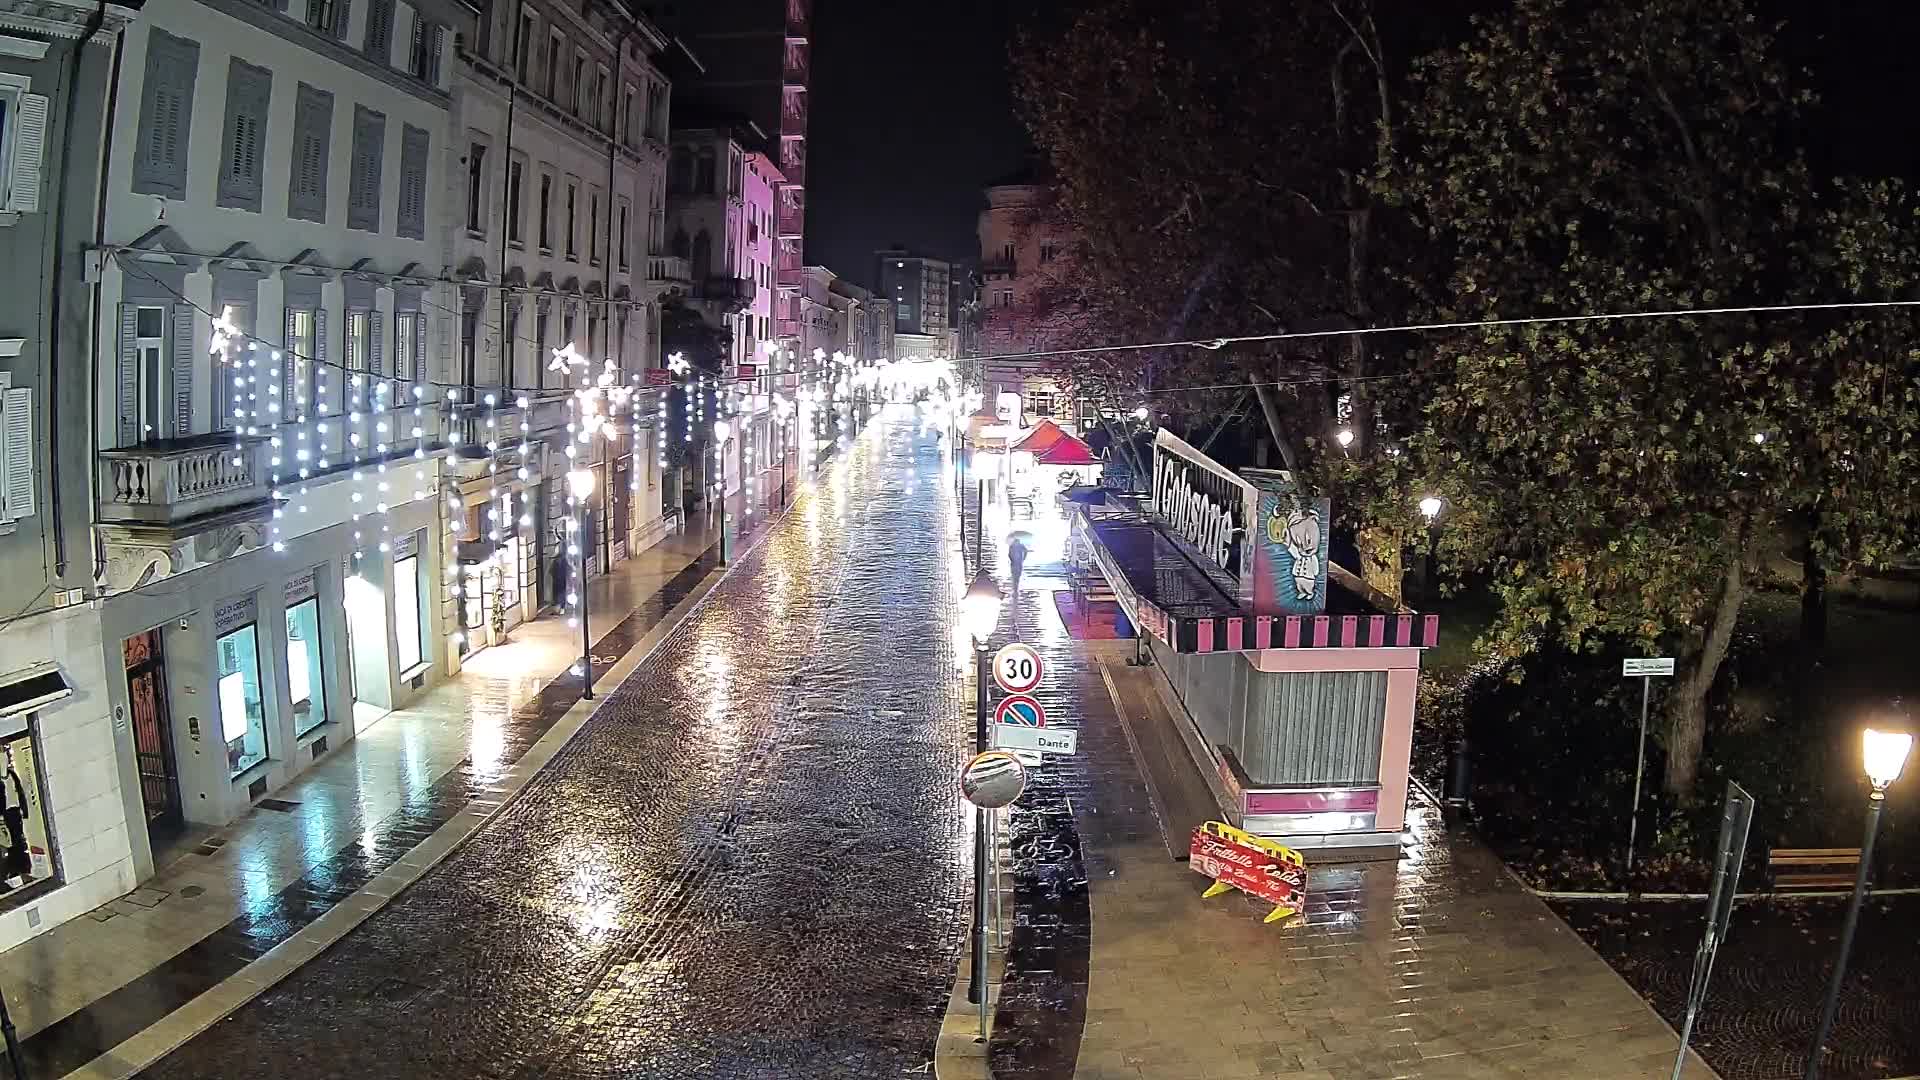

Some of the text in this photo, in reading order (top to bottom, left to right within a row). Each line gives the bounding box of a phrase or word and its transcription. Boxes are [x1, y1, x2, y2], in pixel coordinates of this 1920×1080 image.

[1163, 458, 1233, 570] Golosone
[1006, 659, 1032, 679] 30
[1038, 737, 1069, 749] Dante
[1202, 839, 1253, 868] Frittelle
